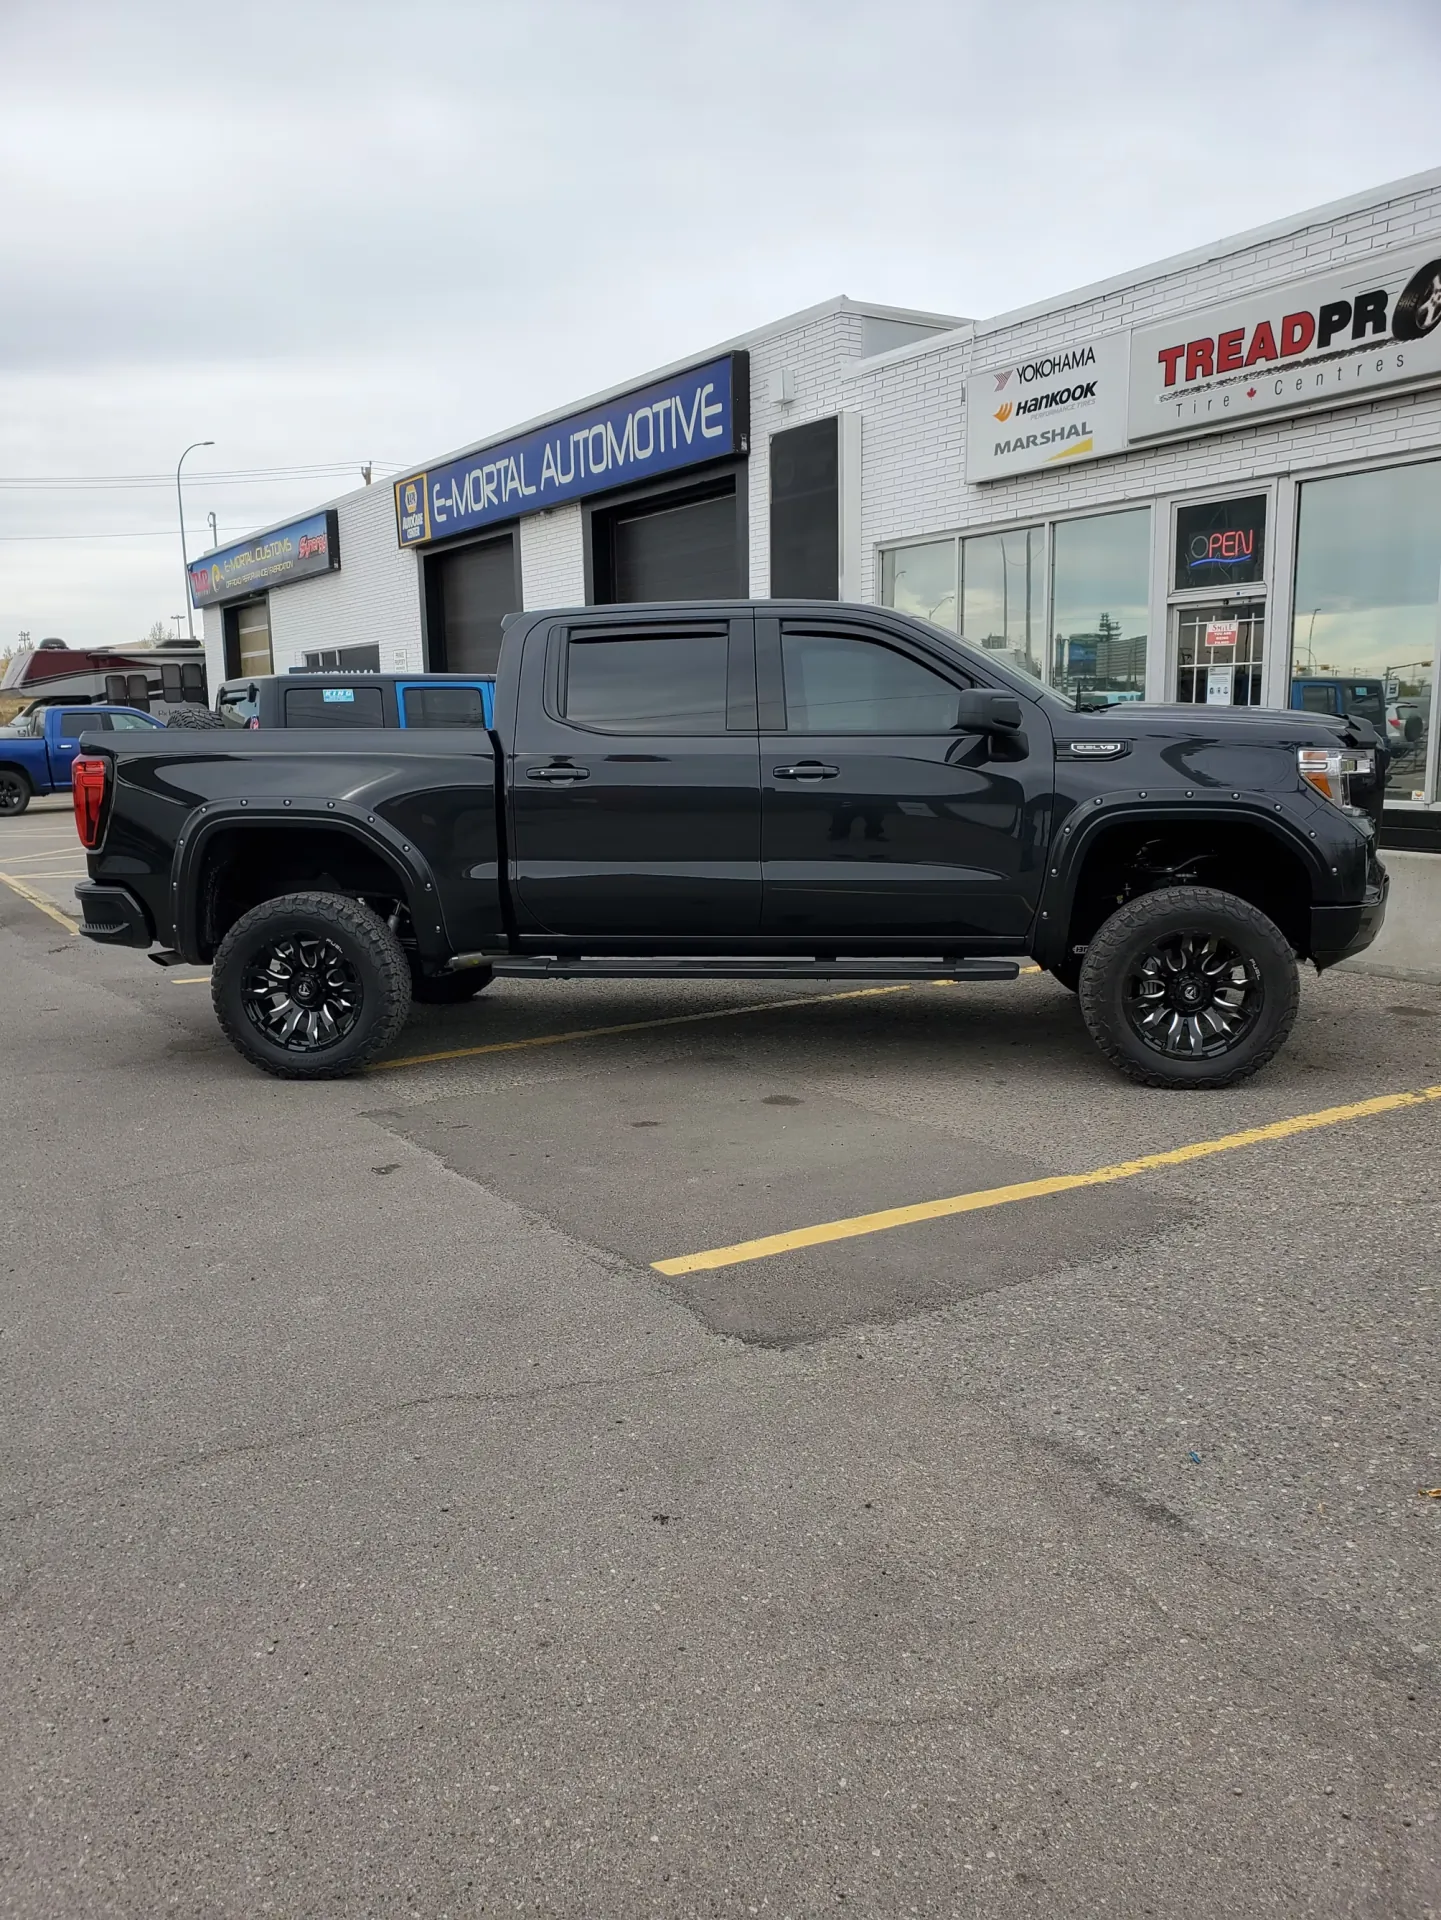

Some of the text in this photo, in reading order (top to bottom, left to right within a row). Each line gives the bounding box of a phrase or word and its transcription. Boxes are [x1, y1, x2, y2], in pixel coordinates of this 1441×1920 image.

[1016, 346, 1096, 384] YOKOHAMA
[1175, 354, 1405, 418] Tire Centres
[433, 383, 723, 523] E-MORTAL AUTOMOTIVE
[994, 421, 1093, 456] MARSHAL
[255, 538, 292, 560] CUSTOMS
[1190, 529, 1253, 559] OPEN
[326, 938, 343, 954] FUEL
